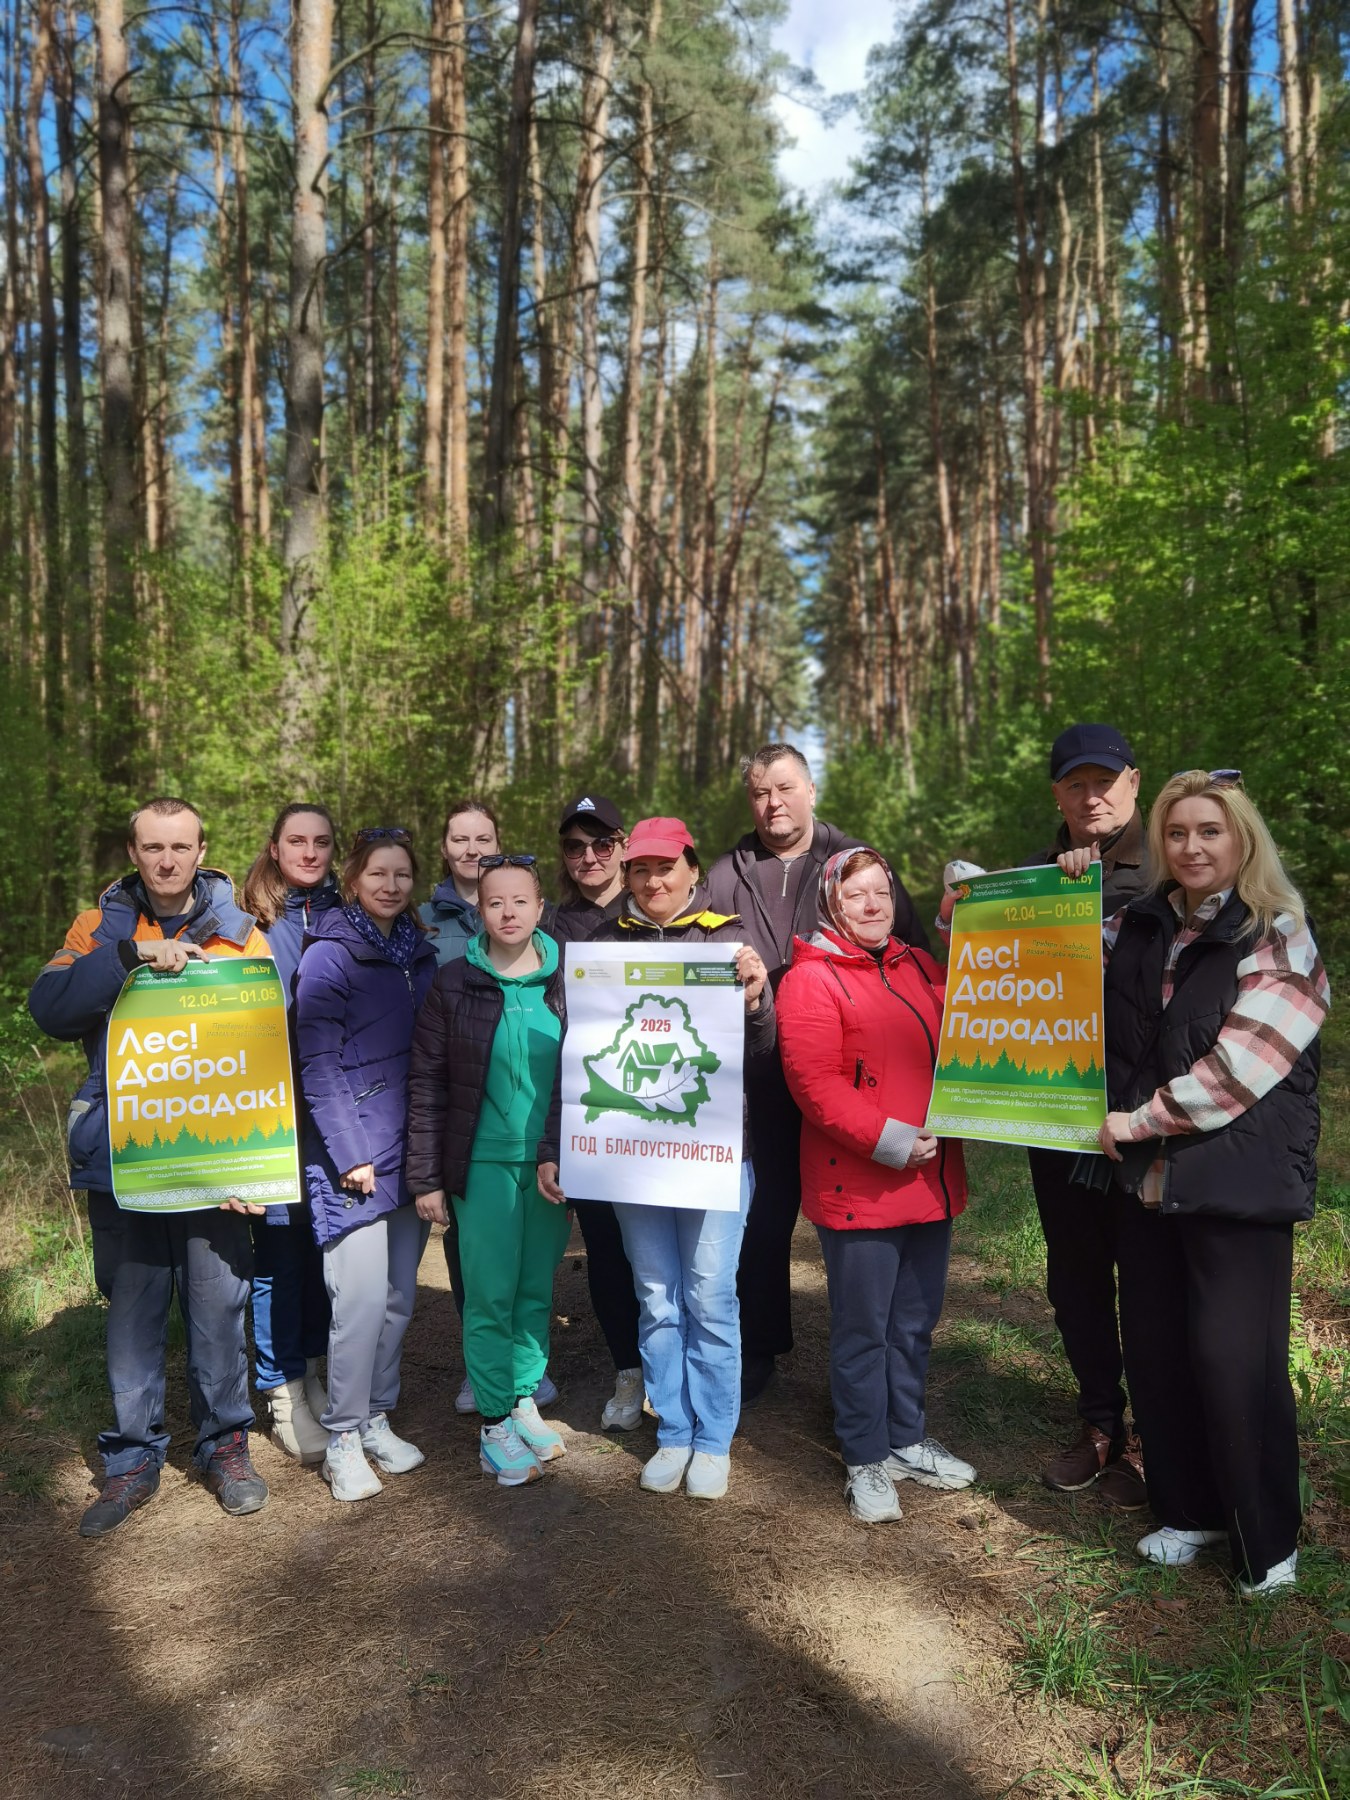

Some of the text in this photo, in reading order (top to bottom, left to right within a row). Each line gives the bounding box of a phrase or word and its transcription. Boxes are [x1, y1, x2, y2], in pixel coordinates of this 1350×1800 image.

[1004, 906, 1036, 921] 12.04
[1055, 902, 1093, 918] 01.05
[242, 965, 270, 975] mlh.by
[957, 939, 1020, 970] Лес!
[179, 993, 218, 1008] 12.04
[240, 987, 277, 1004] 01.05
[952, 971, 1063, 1007] Дабро!
[117, 1023, 198, 1056] Лес!
[640, 1019, 671, 1033] 2025
[947, 1012, 1098, 1045] Парадак!
[115, 1050, 247, 1091] Дабро!
[116, 1082, 286, 1123] Парадак!
[571, 1135, 734, 1164] ГОД БЛАГОУСТРОЙСТВА
